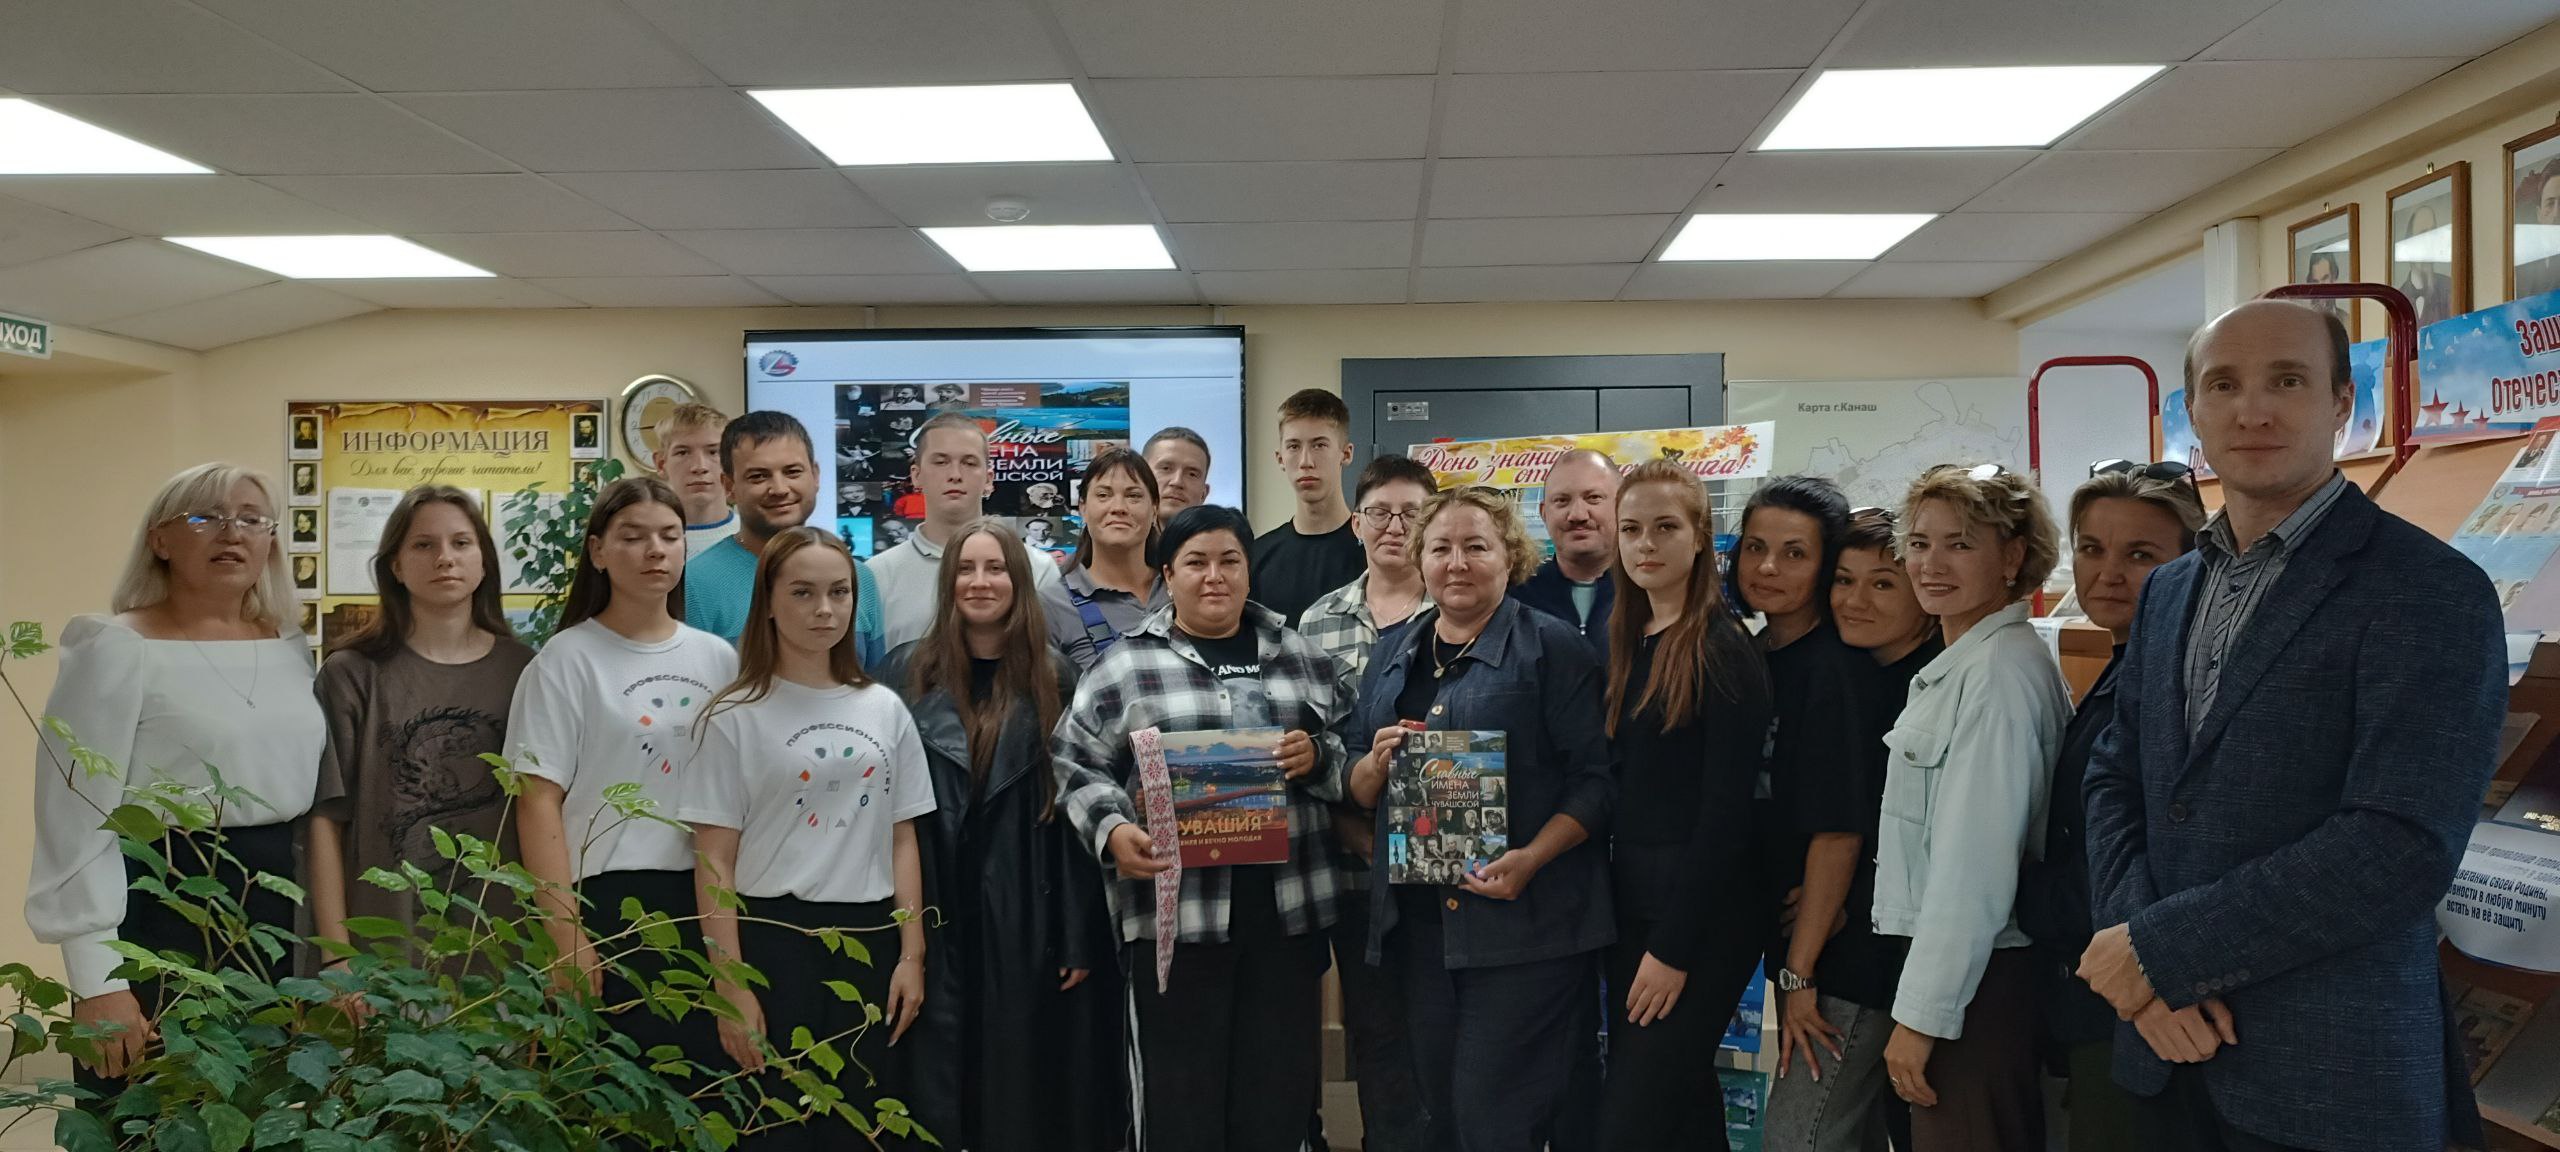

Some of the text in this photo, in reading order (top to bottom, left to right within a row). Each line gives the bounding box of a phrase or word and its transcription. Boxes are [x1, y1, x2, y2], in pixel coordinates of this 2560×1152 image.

[2491, 369, 2560, 414] Отечес
[1798, 402, 1831, 414] Карта
[342, 431, 549, 458] ИНФОРМАЦИЯ
[988, 445, 1039, 457] ЕНА
[350, 458, 387, 477] Для
[1419, 446, 1479, 472] День
[993, 471, 1064, 482] ШСКОЙ
[1419, 758, 1480, 782] Славные
[1431, 780, 1470, 790] ИМЕНА
[1431, 799, 1480, 808] ЧУВАШСКОЙ
[1447, 790, 1479, 800] ЗЕМЛИ
[1180, 816, 1261, 836] УВАШИЯ
[2446, 899, 2470, 916] встать
[2471, 906, 2481, 919] на
[2485, 893, 2513, 911] любую
[2515, 899, 2547, 921] минуту
